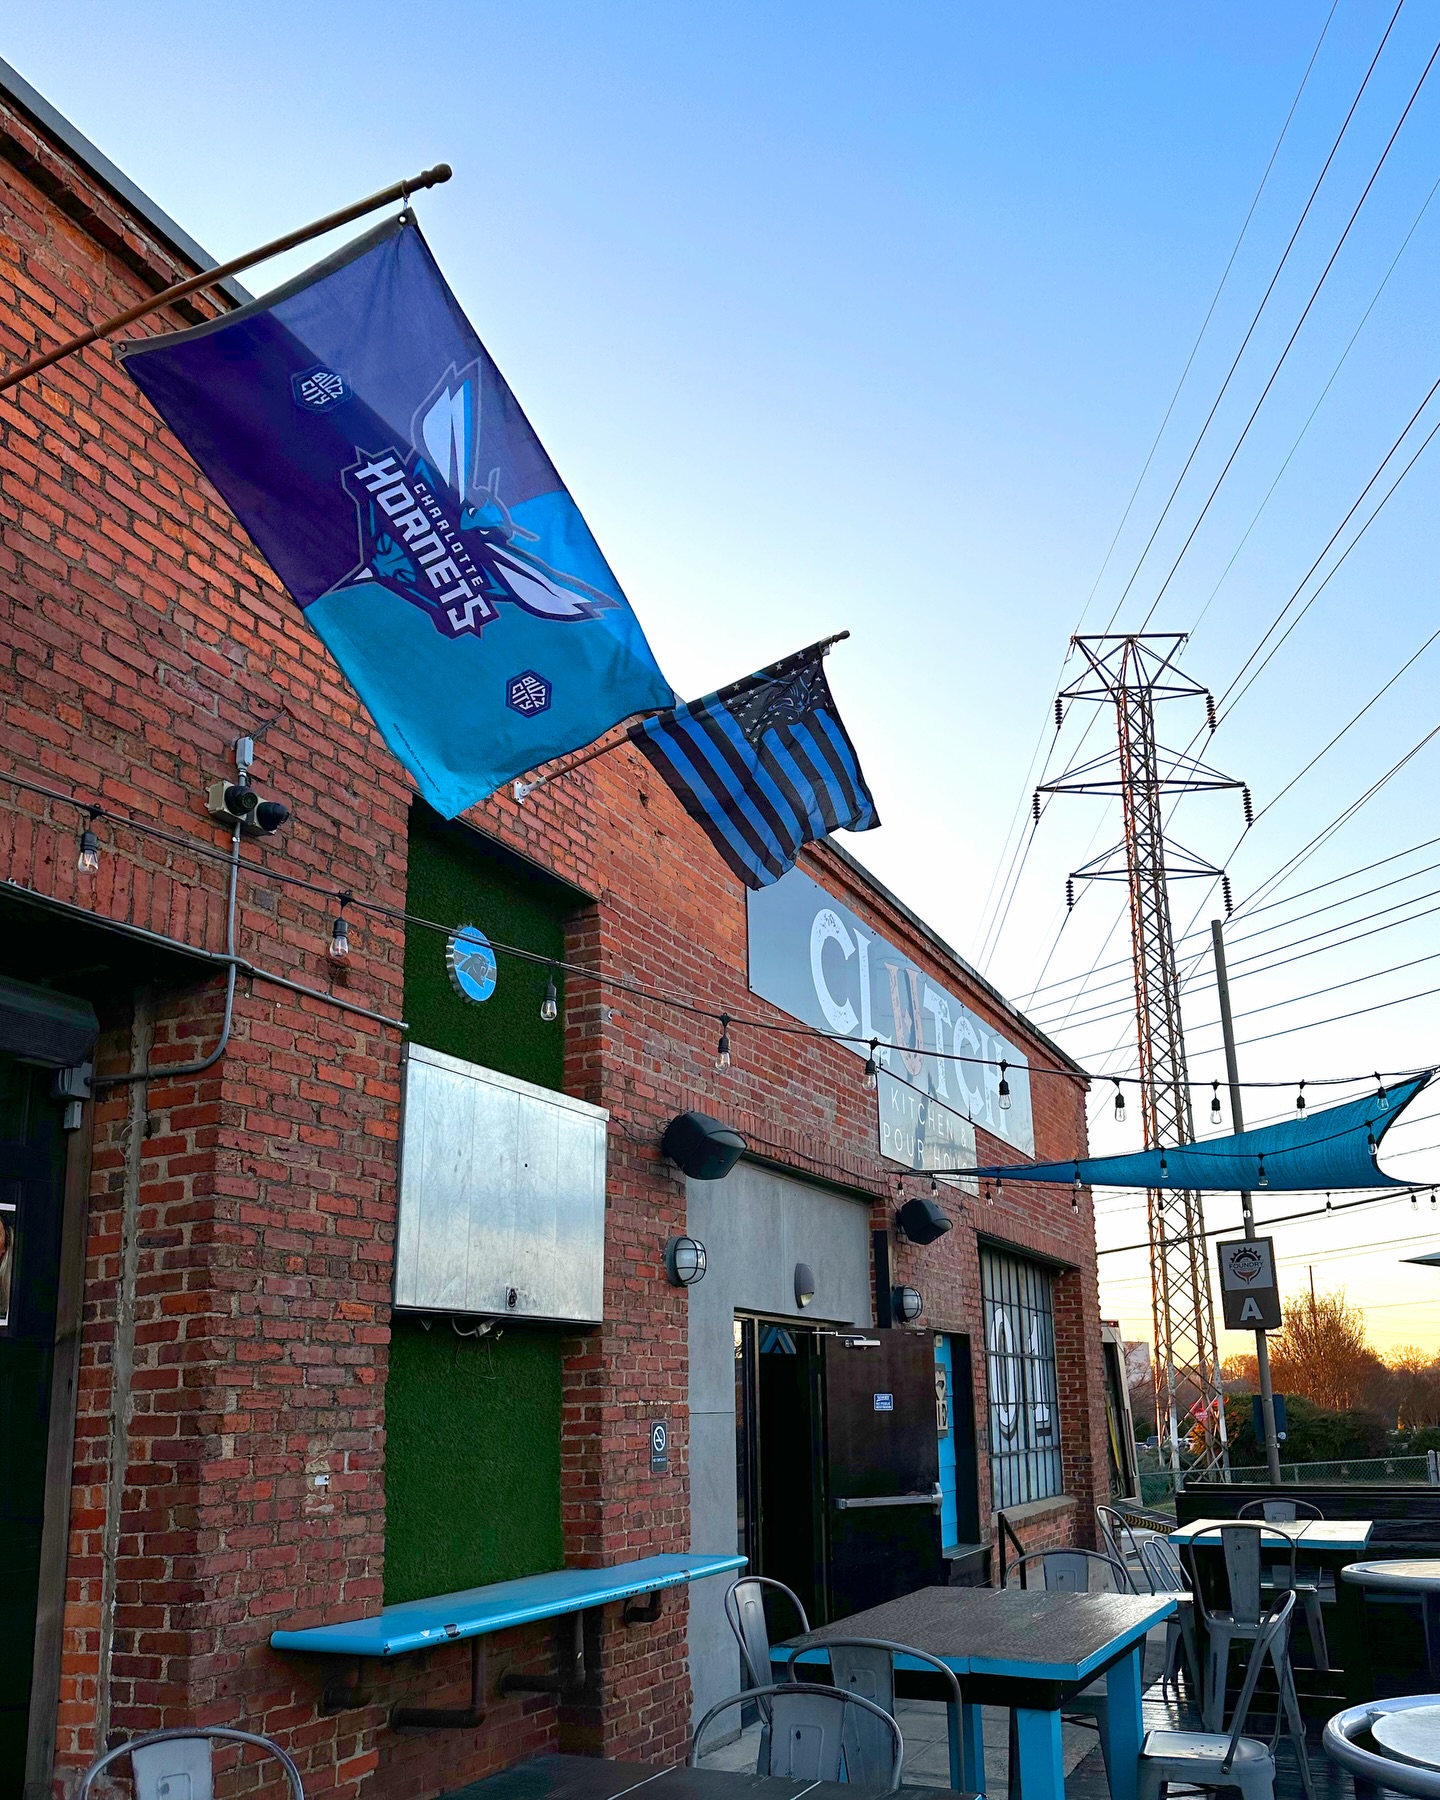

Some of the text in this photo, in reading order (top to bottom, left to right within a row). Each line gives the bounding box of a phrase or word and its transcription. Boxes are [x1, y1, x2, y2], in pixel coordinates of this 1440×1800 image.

[301, 380, 331, 405] CITY
[312, 372, 343, 399] BUZZ
[354, 456, 492, 631] HORNETS
[413, 482, 484, 587] CHARLOTTE
[512, 682, 534, 710] CITY
[521, 676, 546, 708] BUZZ
[809, 908, 1010, 1137] CLUTCH
[890, 1087, 954, 1140] KITCHEN
[883, 1122, 925, 1162] POUR
[1228, 1261, 1264, 1269] FOUNDRY
[1240, 1296, 1264, 1321] A
